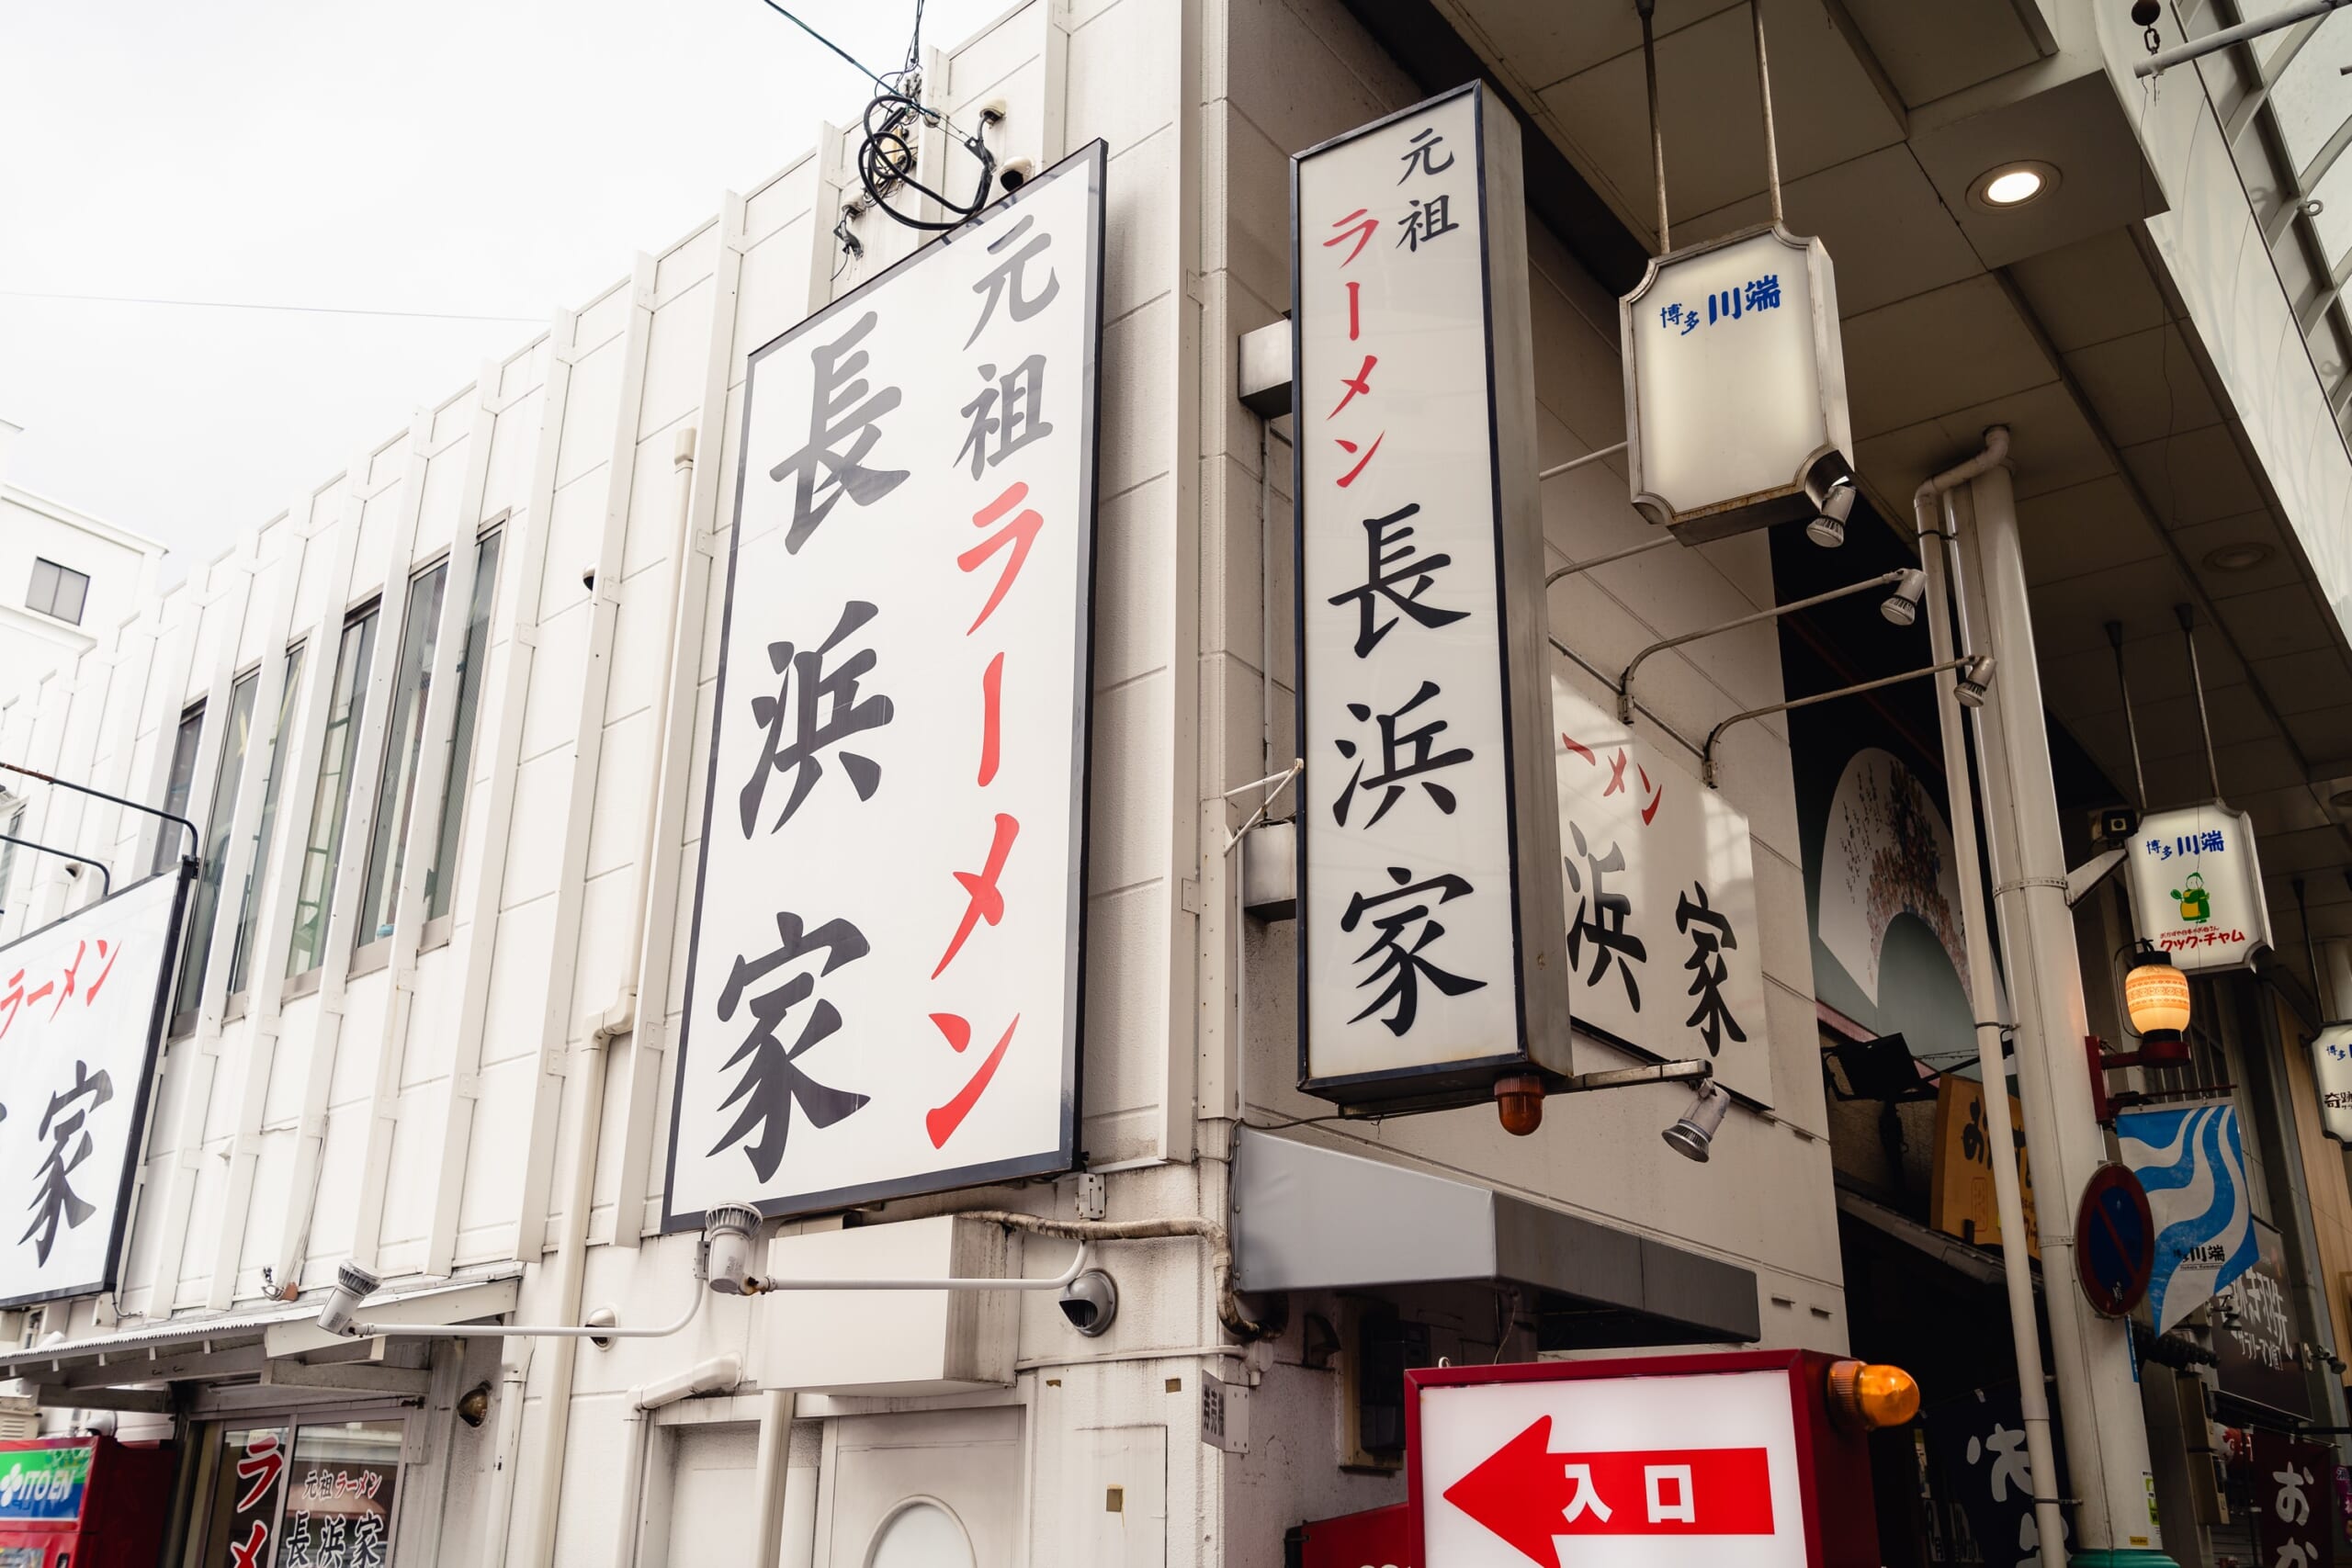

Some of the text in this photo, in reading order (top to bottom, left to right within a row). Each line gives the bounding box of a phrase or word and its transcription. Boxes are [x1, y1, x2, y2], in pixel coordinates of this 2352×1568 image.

[1396, 129, 1459, 252] 元祖
[1660, 275, 1782, 336] 博多川端
[707, 311, 910, 1183] 長浜家
[2146, 830, 2224, 861] 博多川端
[1562, 1463, 1695, 1523] 入口
[287, 1509, 384, 1568] 長浜家
